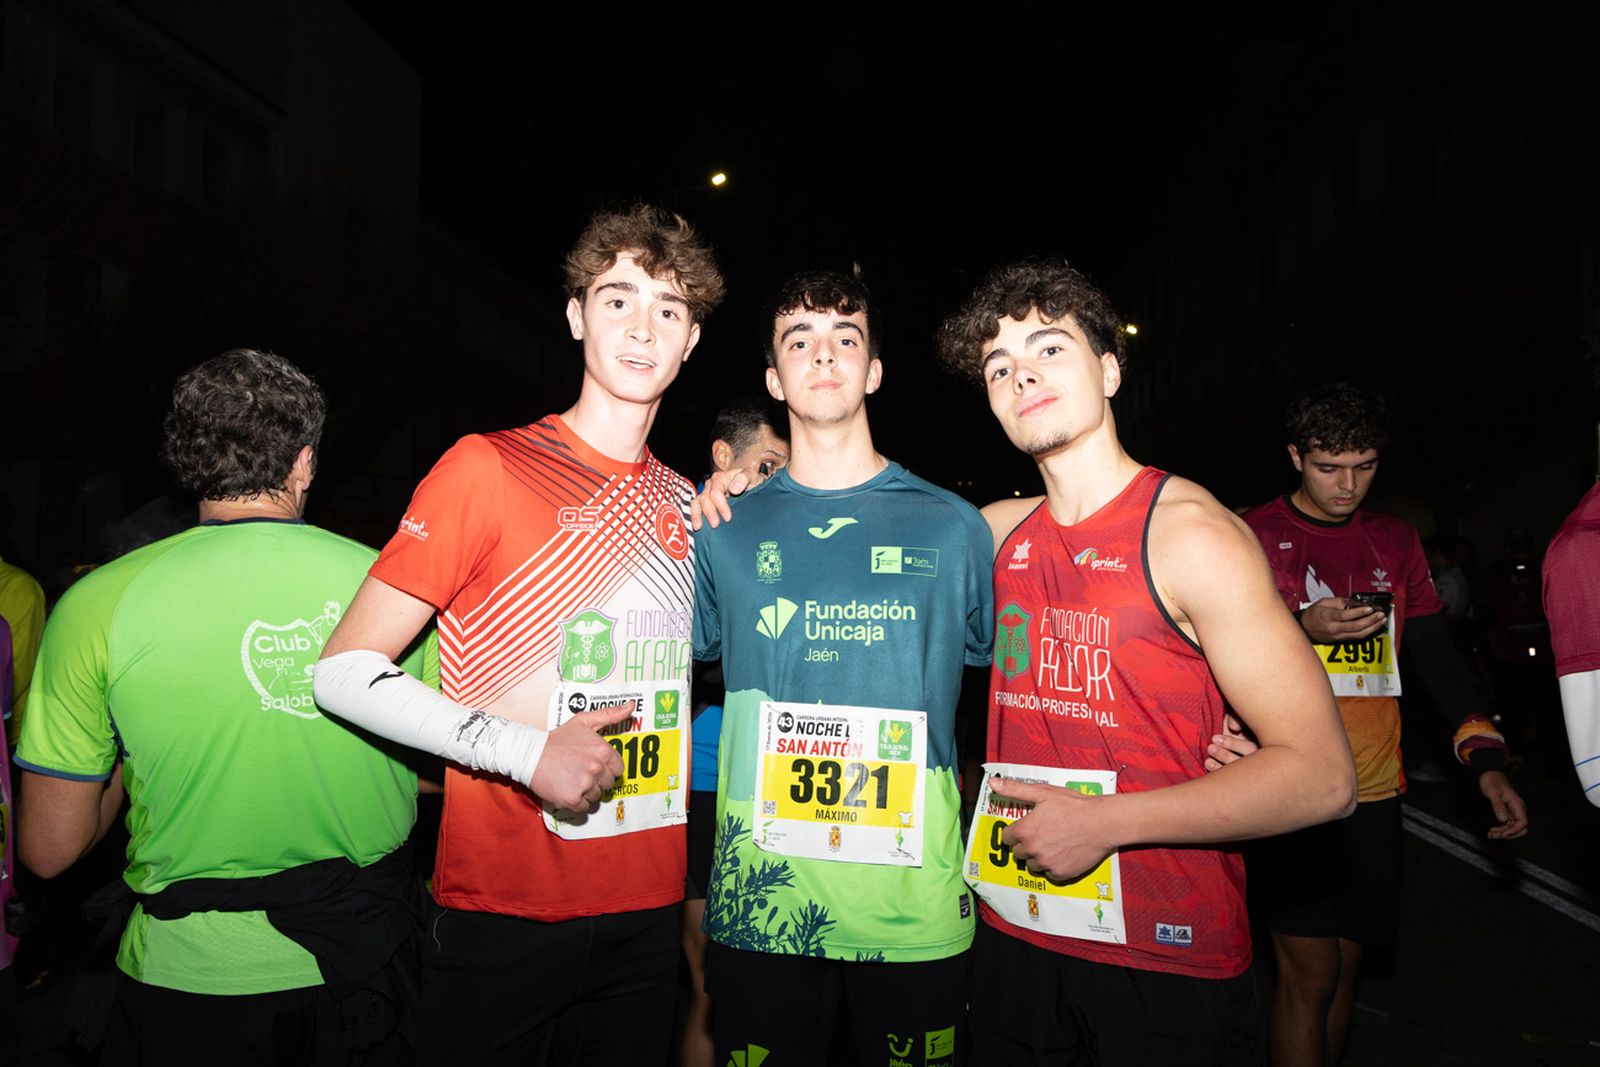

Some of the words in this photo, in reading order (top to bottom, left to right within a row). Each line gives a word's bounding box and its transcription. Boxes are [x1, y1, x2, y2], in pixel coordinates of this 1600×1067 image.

[805, 599, 916, 621] Fundación
[805, 621, 884, 647] Unicaja
[254, 633, 311, 653] Club
[1327, 637, 1384, 664] 2997
[252, 657, 294, 669] Vega
[804, 648, 839, 662] Jaén
[261, 694, 314, 711] Salob
[570, 696, 585, 709] 43
[777, 714, 794, 728] 43
[795, 721, 842, 737] NOCHE
[776, 737, 807, 754] SAN
[809, 739, 863, 758] ANTÓN
[789, 757, 890, 809] 3321
[815, 807, 858, 823] MÁXIMO
[987, 799, 1005, 816] SAN
[1006, 801, 1036, 819] ANT
[1017, 874, 1046, 891] Daniel
